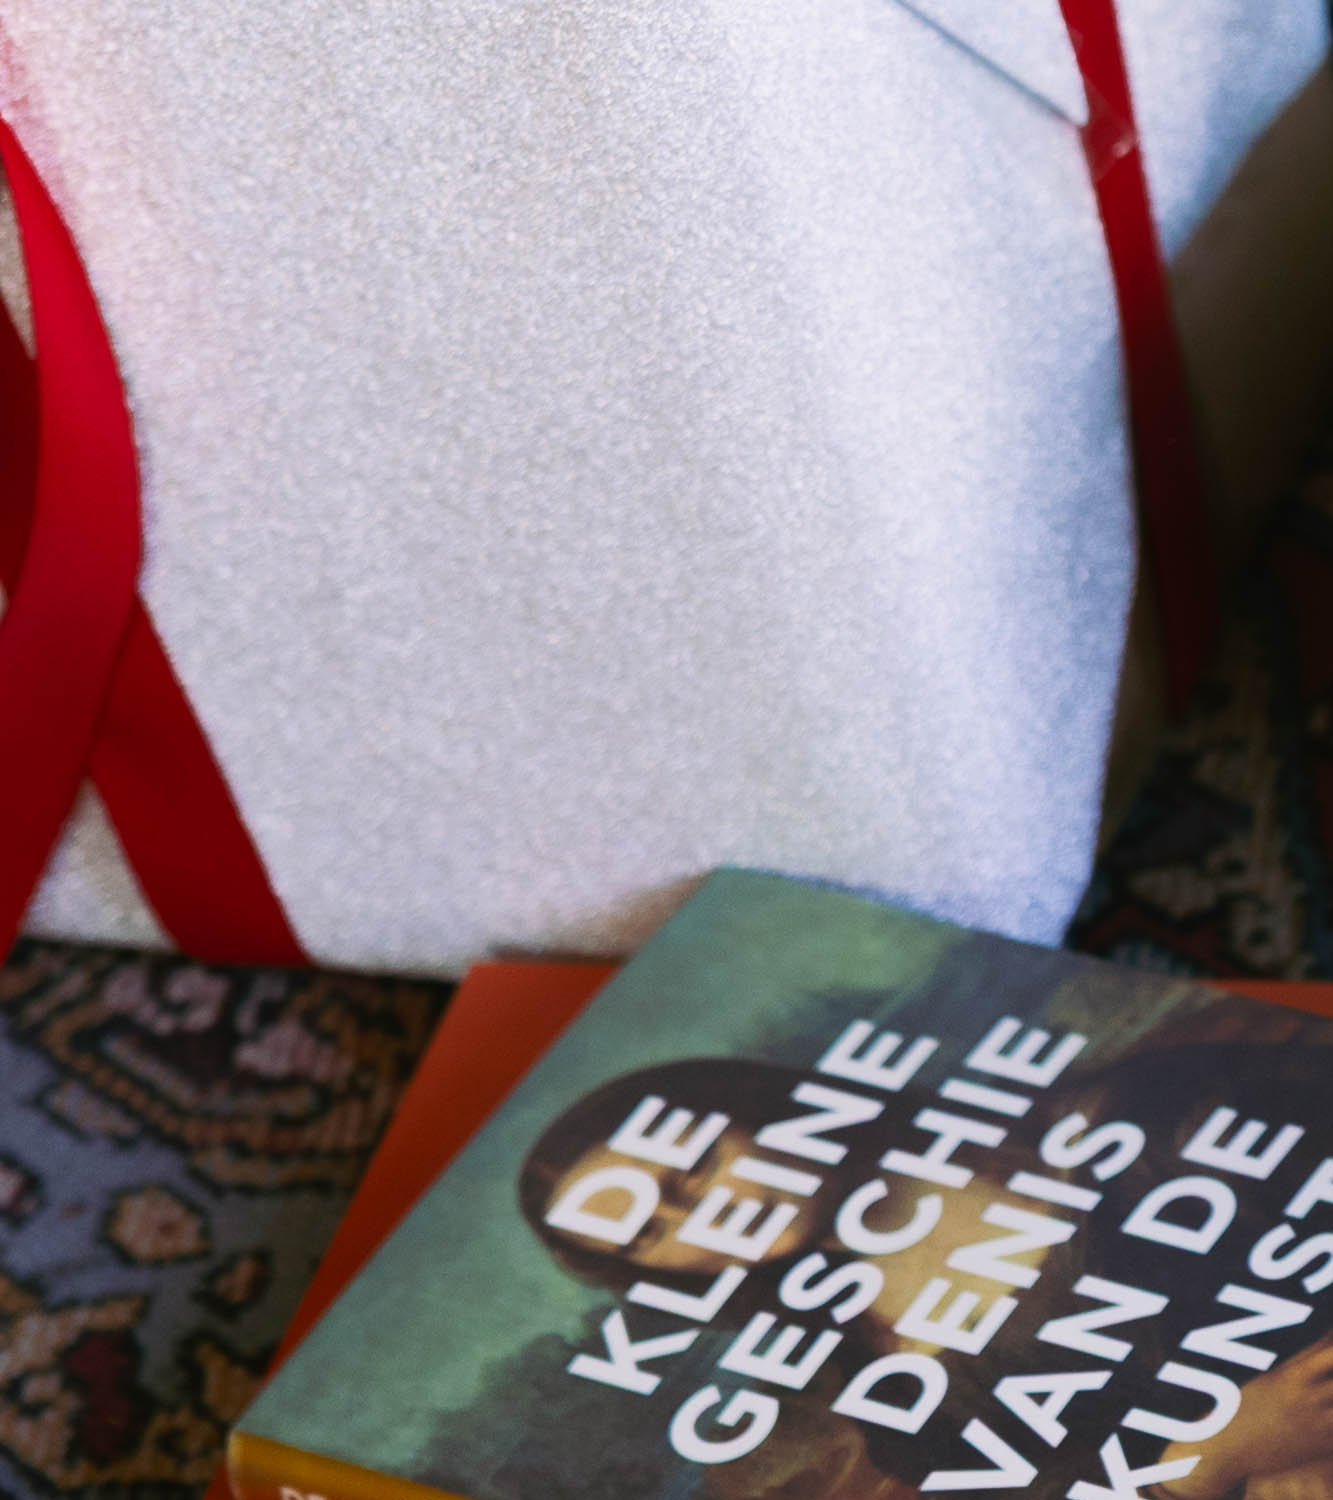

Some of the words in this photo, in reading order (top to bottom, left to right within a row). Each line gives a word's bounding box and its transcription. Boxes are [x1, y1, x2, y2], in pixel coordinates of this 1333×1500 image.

[545, 1094, 731, 1246] DE
[566, 1019, 940, 1395] KLEINE
[669, 1016, 1088, 1464] GESCHIE
[831, 1112, 1146, 1435] DENIS
[919, 1273, 1170, 1493] VAN
[1122, 1106, 1305, 1255] DE
